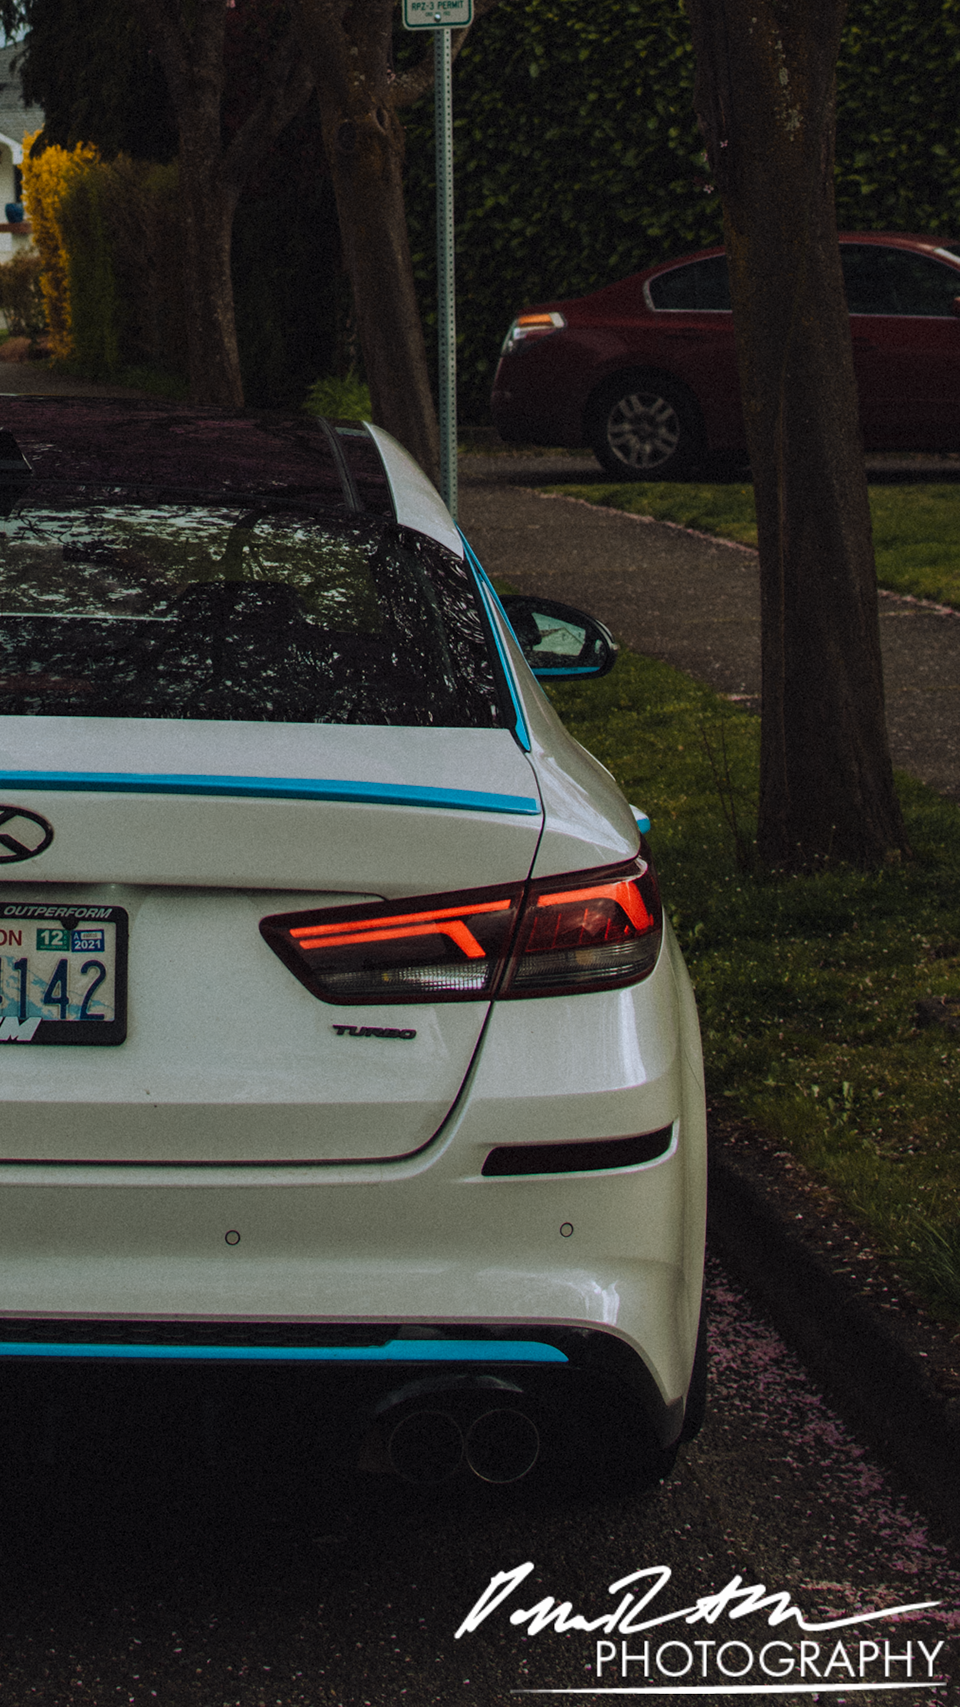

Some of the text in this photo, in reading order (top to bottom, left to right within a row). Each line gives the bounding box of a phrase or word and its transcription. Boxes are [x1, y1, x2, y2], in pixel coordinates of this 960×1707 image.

[411, 0, 464, 11] RPZ-3 PERMIT
[3, 905, 113, 919] OUTPERFORM
[40, 930, 63, 945] 12
[74, 939, 101, 950] 2021
[332, 1024, 417, 1039] TURBO
